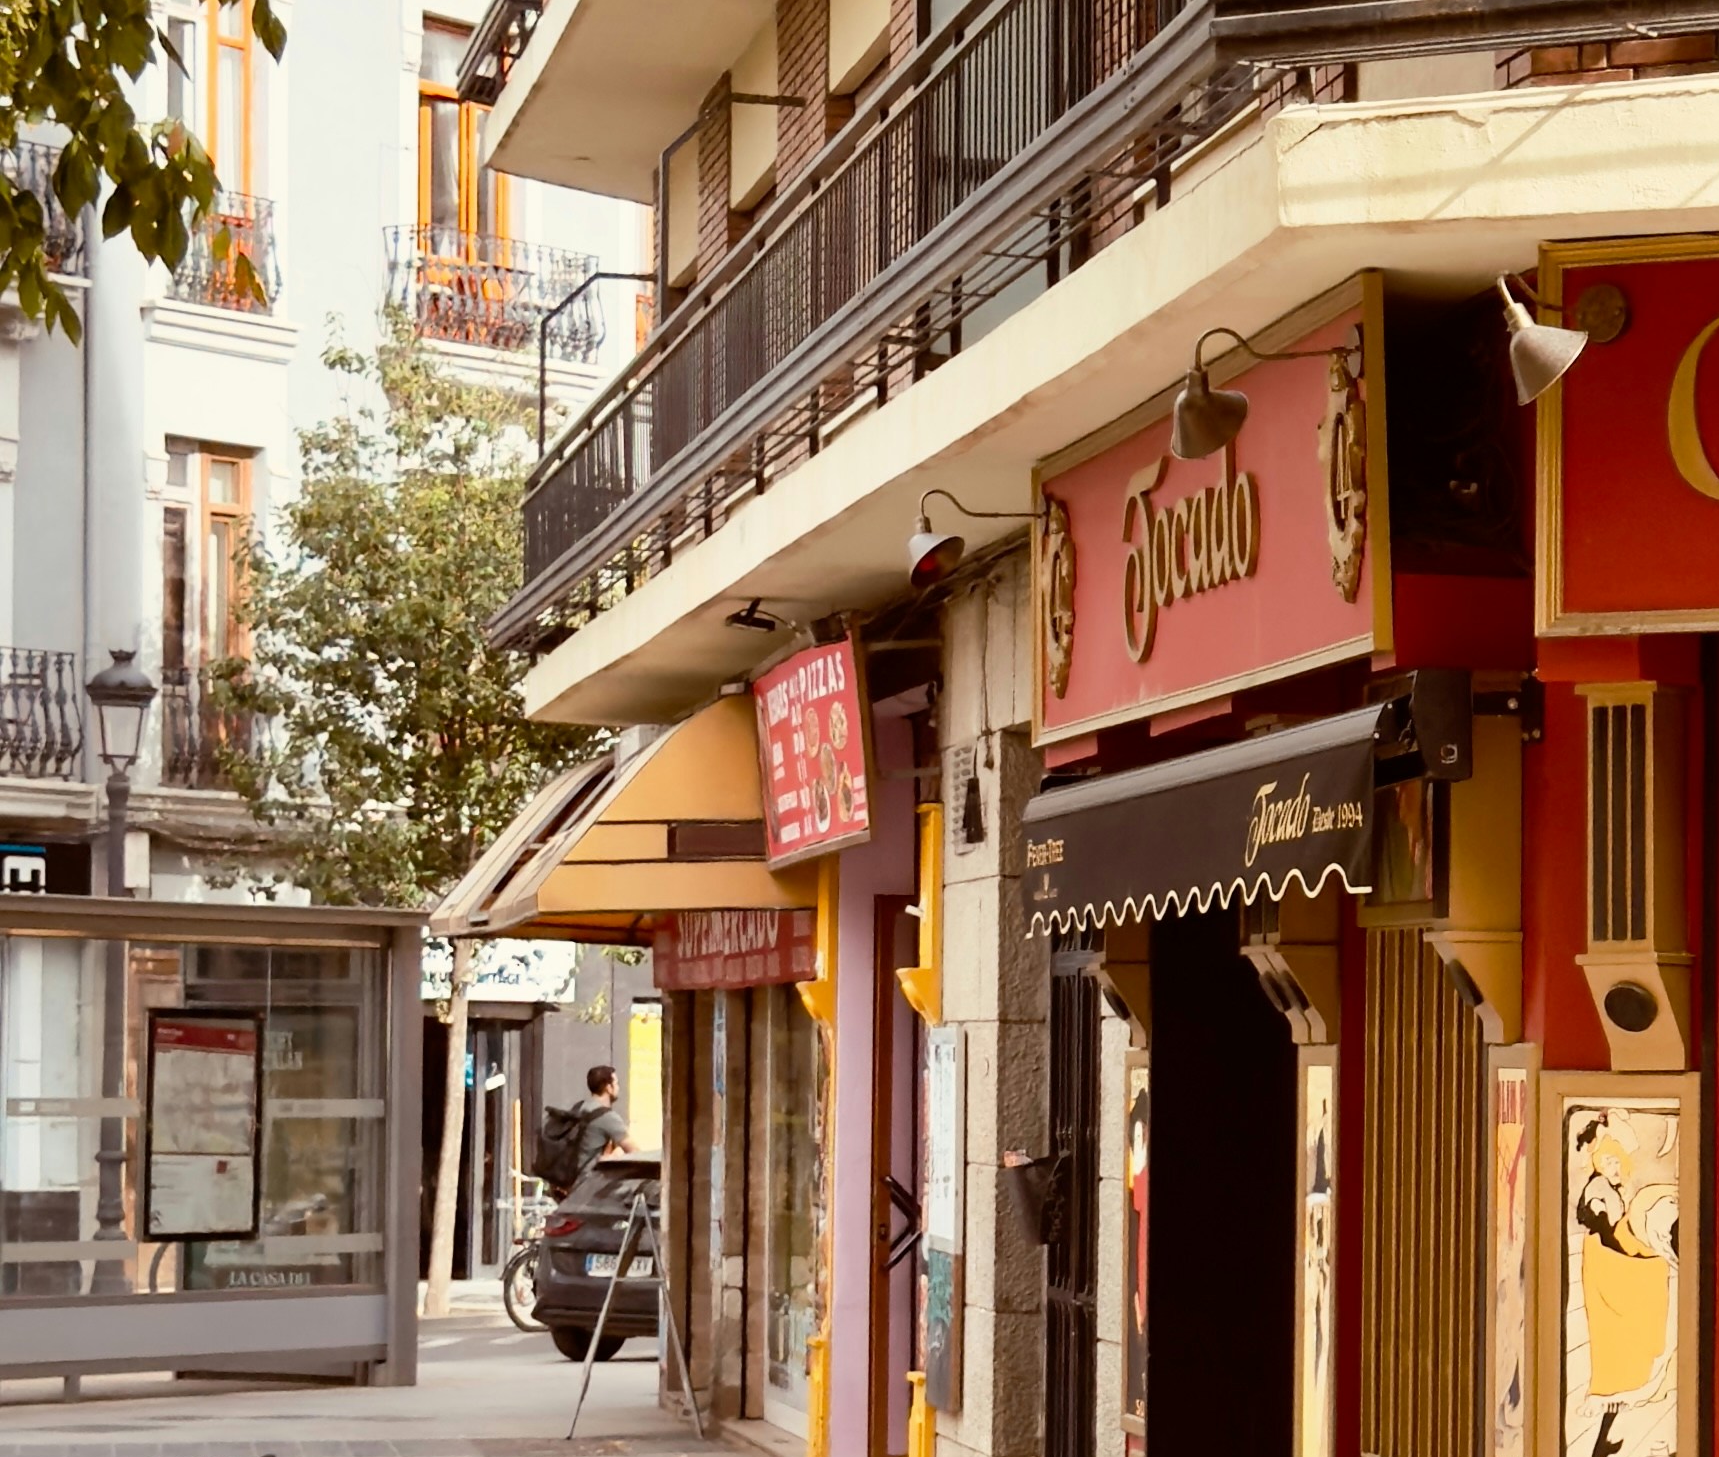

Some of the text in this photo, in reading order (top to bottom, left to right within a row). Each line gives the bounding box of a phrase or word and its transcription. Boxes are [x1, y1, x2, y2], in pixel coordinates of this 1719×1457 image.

[1122, 441, 1258, 663] Tocado
[798, 651, 845, 704] PIZZAS
[1245, 772, 1363, 867] Tocado Desde 1994
